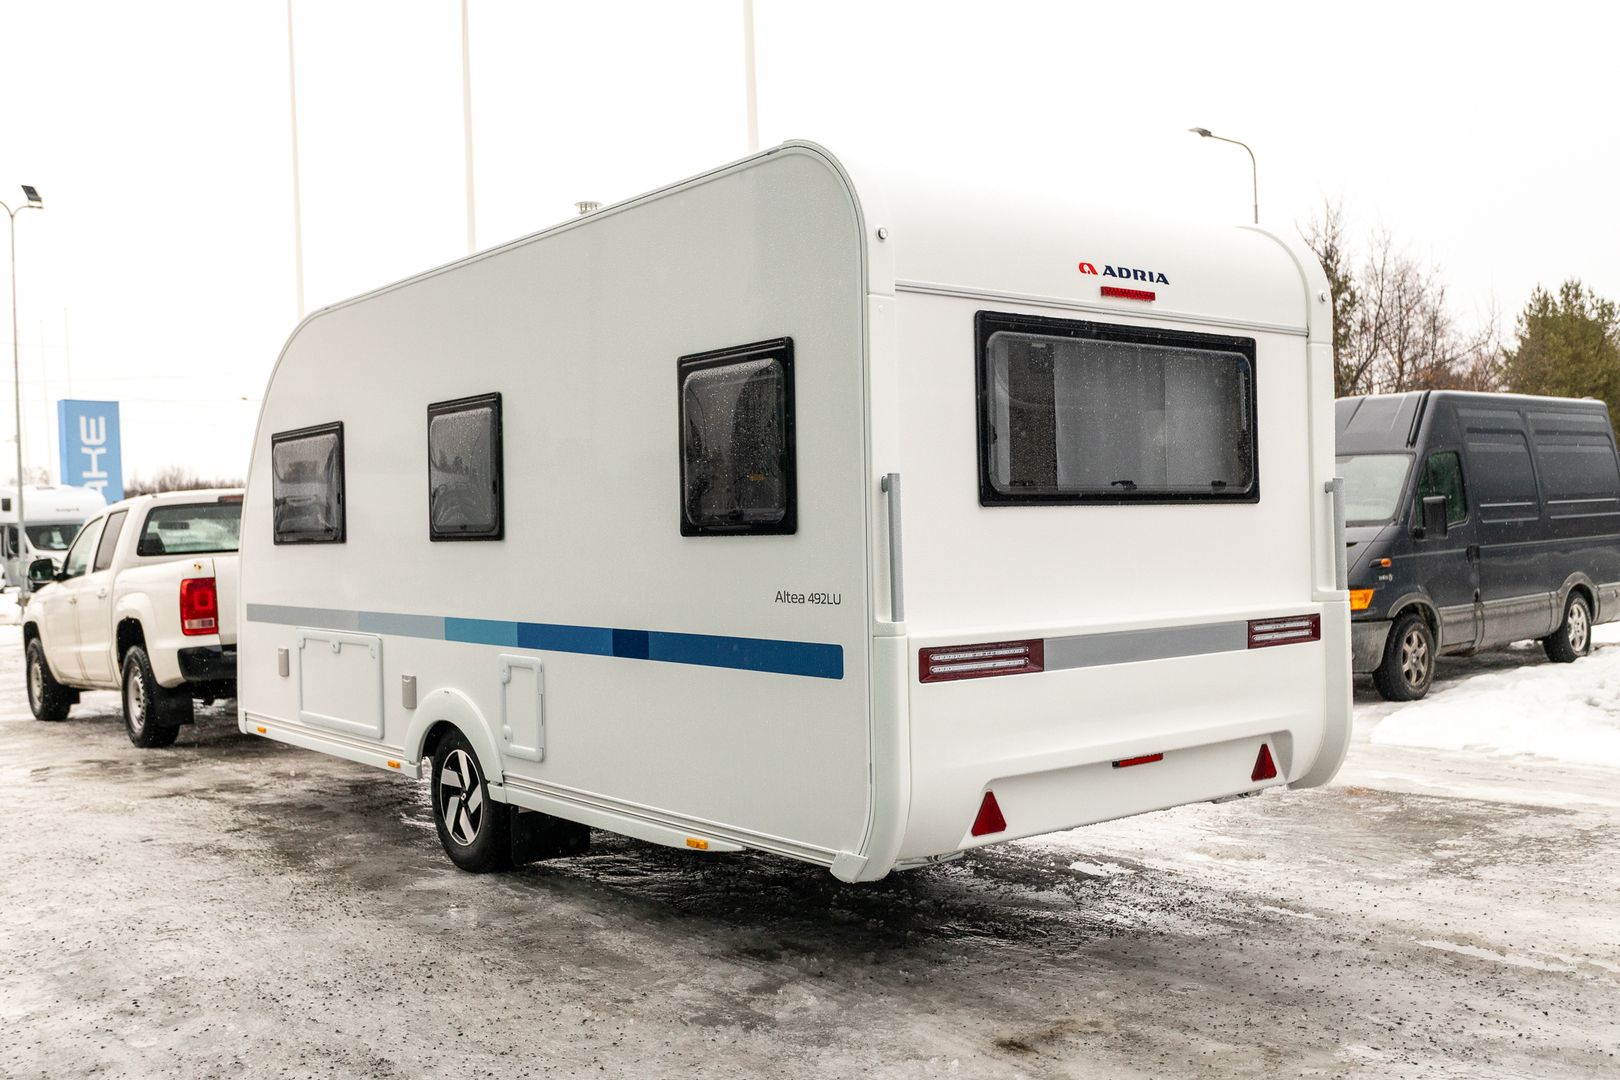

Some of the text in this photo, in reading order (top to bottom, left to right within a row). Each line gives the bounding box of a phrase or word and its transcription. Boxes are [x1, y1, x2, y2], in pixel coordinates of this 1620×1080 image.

[1102, 264, 1170, 285] ADRIA
[774, 590, 842, 605] Altea 492LU
